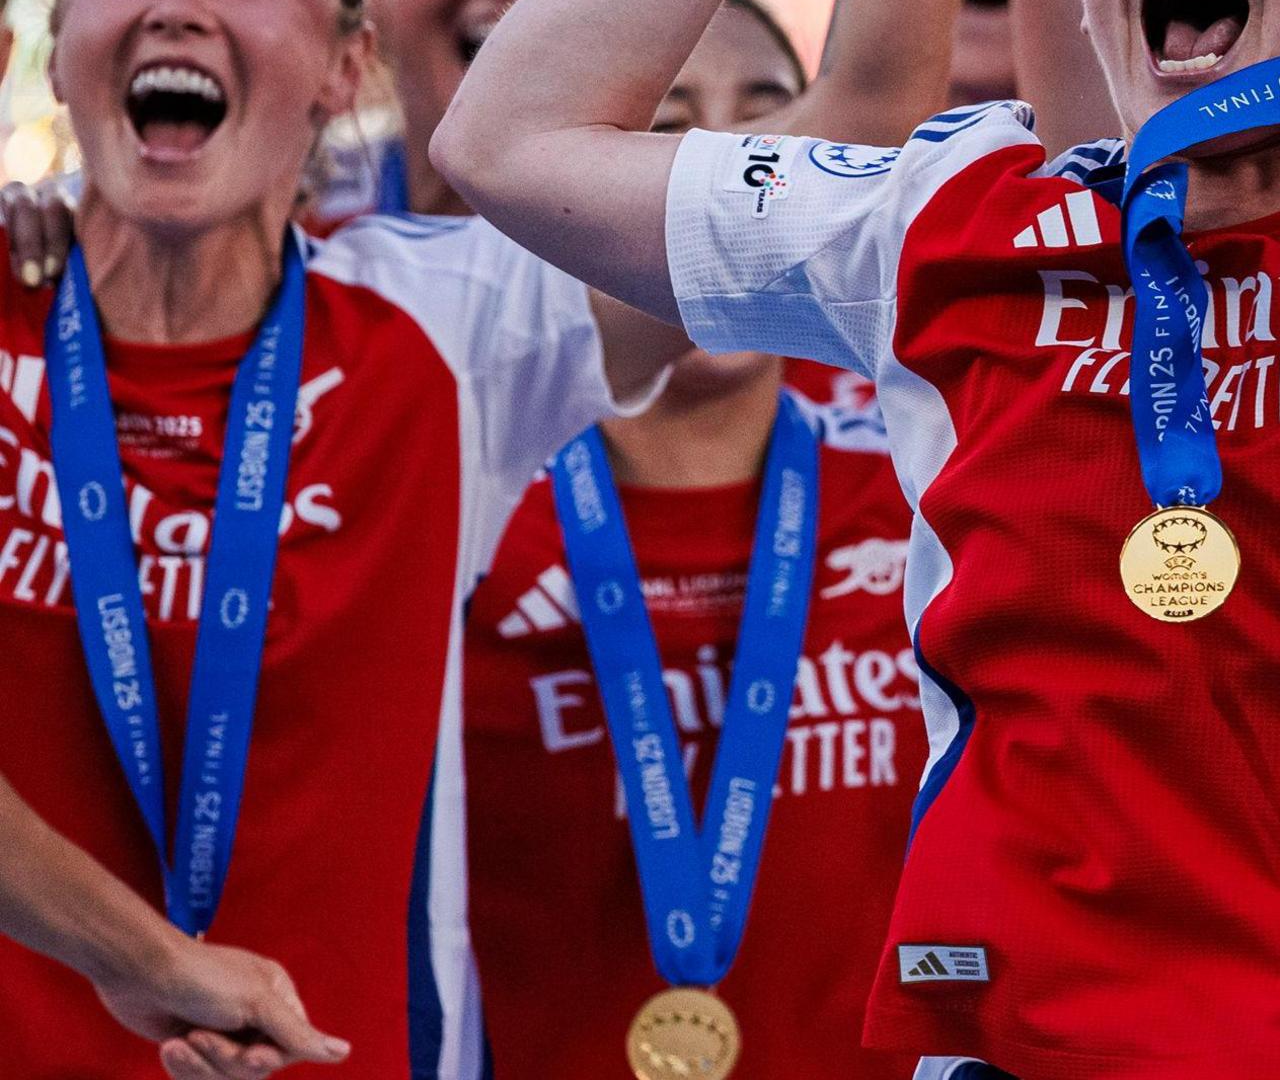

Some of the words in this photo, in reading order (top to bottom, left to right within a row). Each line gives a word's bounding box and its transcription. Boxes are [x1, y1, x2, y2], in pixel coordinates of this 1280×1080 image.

[1199, 84, 1275, 118] FINAL
[743, 152, 780, 188] 10
[1140, 269, 1171, 337] FINAL
[1150, 347, 1175, 378] 25
[246, 398, 277, 431] 25
[234, 431, 271, 512] LISBON
[1133, 582, 1225, 595] CHAMPIONS
[1151, 596, 1209, 607] LEAGUE
[97, 592, 136, 678] LISBON
[112, 678, 143, 711] 25
[193, 790, 222, 822] 25
